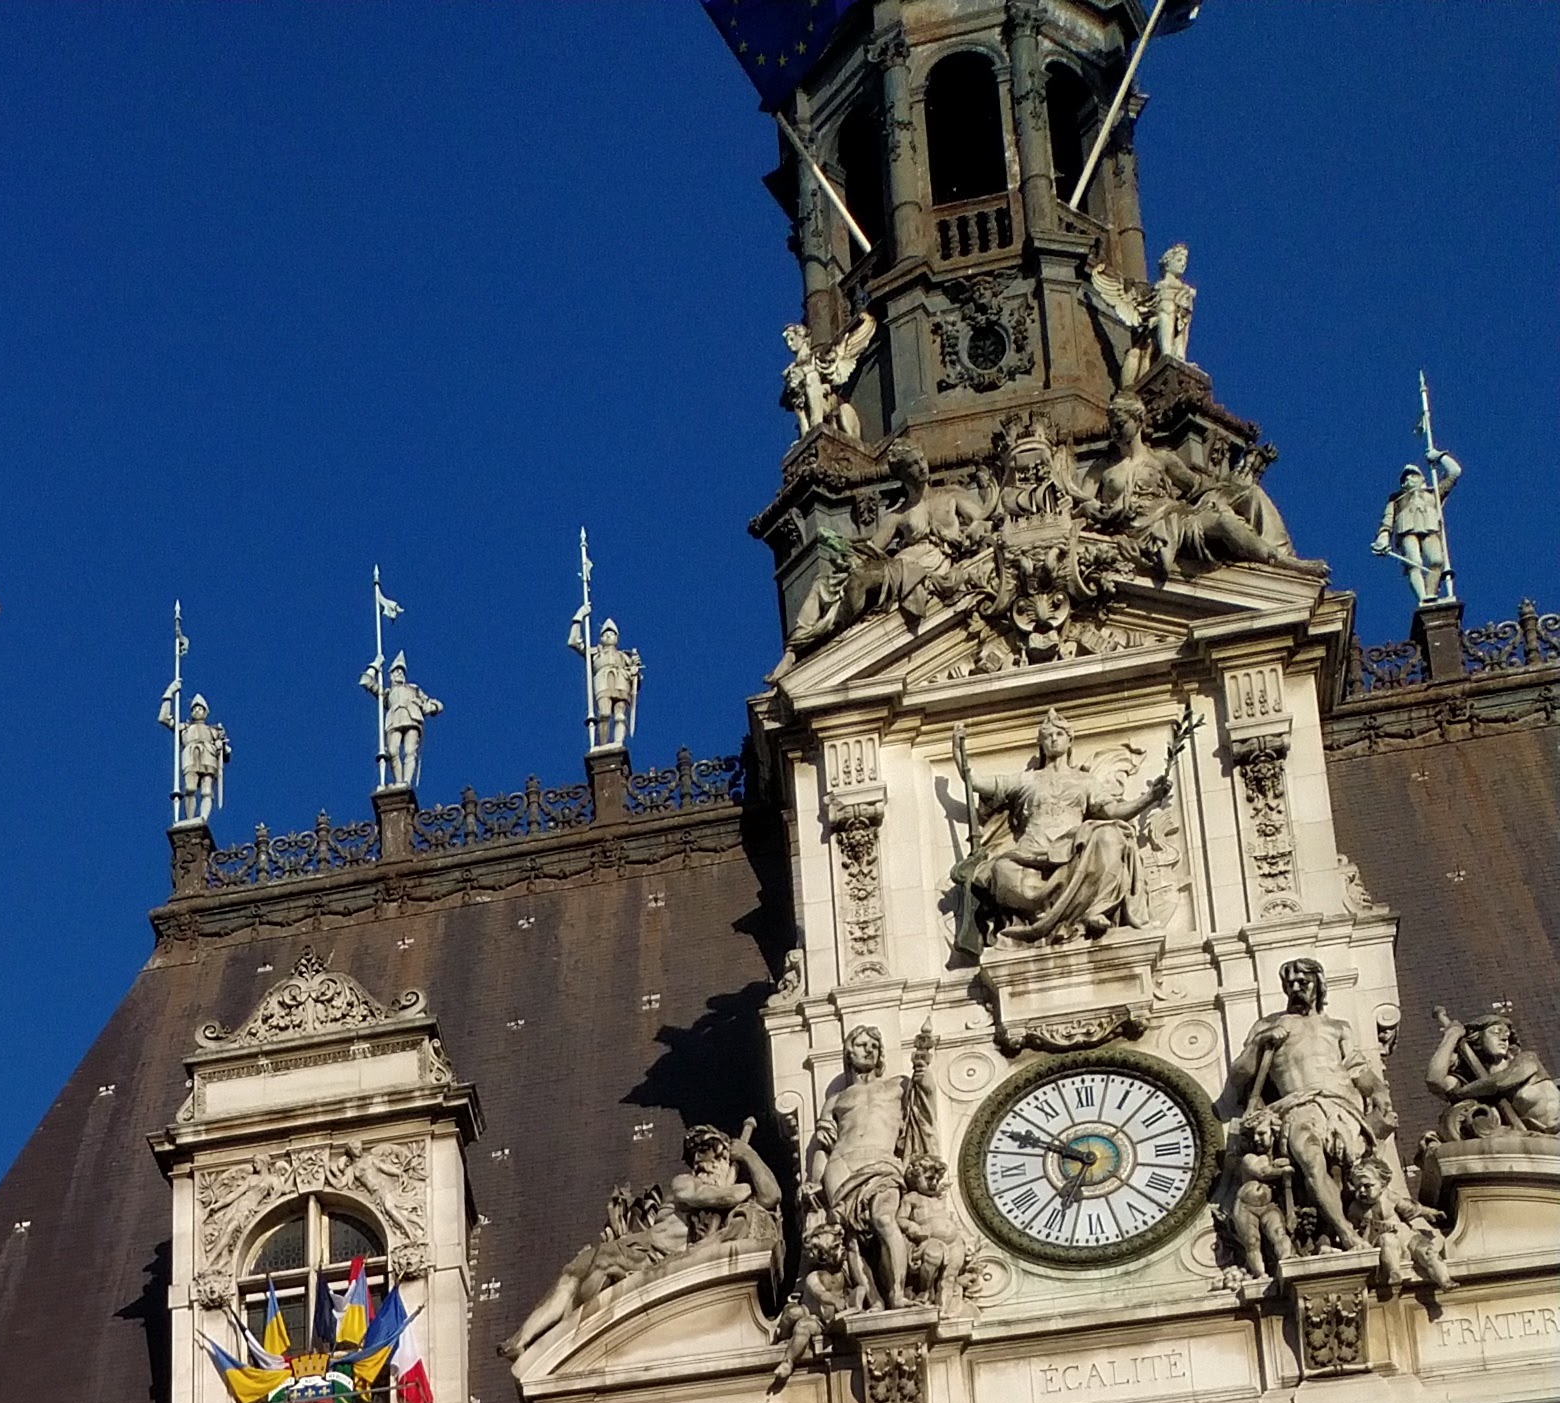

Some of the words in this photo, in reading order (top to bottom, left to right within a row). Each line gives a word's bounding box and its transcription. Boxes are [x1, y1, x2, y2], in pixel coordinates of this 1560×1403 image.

[1074, 1085, 1095, 1109] XII
[1141, 1109, 1168, 1128] II
[1154, 1141, 1181, 1158] III
